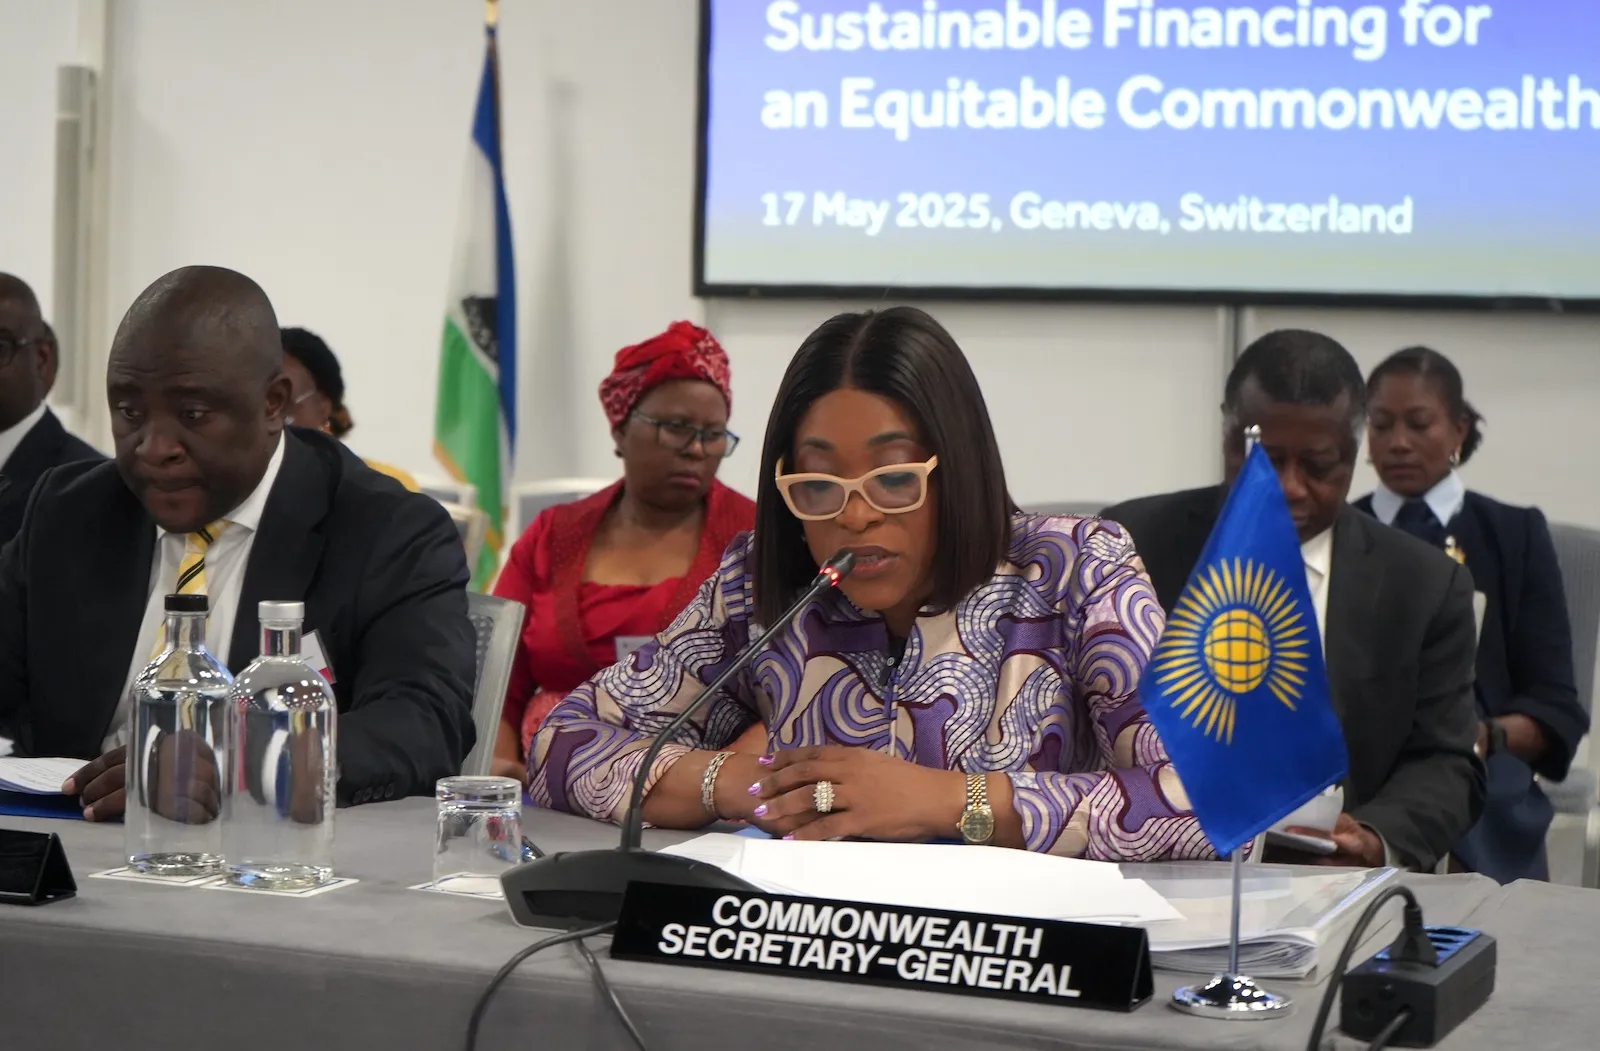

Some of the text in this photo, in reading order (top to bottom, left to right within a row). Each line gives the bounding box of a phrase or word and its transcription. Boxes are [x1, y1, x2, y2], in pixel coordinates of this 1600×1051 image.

[764, 0, 1492, 61] Sustainable Financing for
[761, 74, 1600, 140] an Equitable Commonwealth
[760, 190, 1414, 236] 17 May 2025, Geneva, Switzerland
[711, 895, 1043, 959] COMMONWEALTH
[657, 922, 1081, 998] SECRETARY-GENERAL
